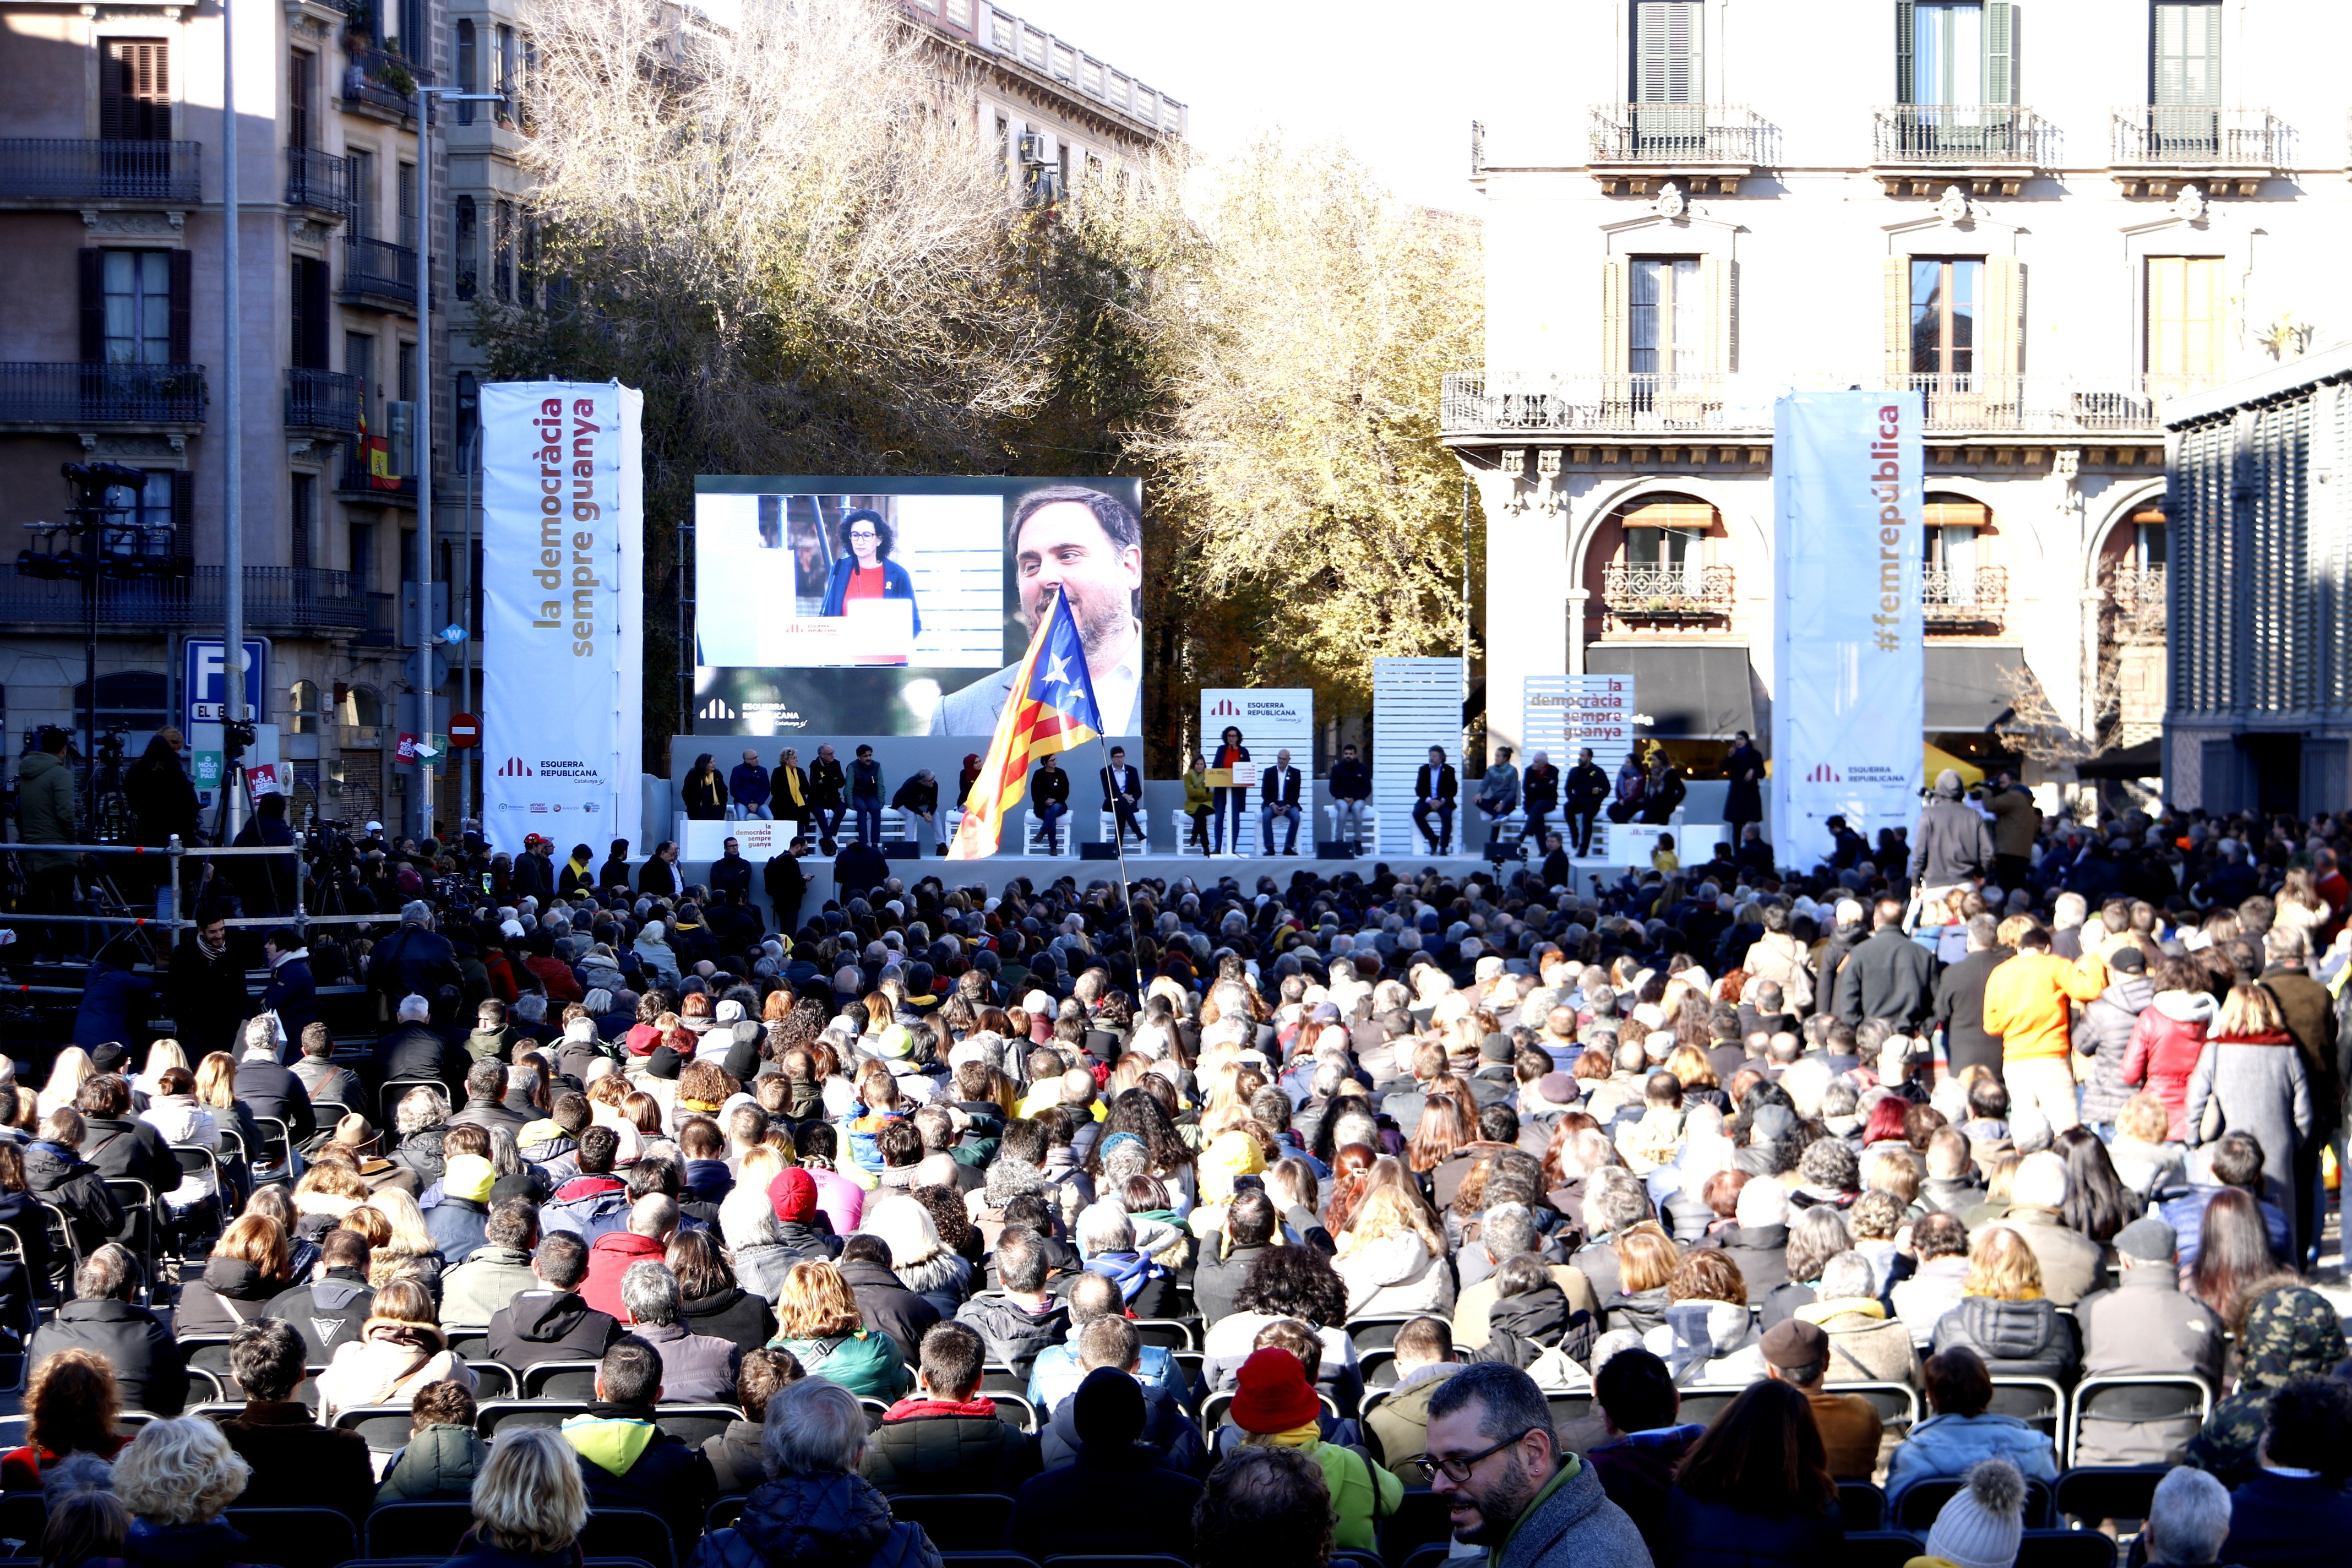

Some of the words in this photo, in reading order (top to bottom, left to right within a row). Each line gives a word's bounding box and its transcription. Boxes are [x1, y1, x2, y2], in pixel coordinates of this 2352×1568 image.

[573, 399, 600, 522] guanya
[532, 399, 562, 590] democràcia
[1871, 405, 1906, 652] #femrepública
[573, 531, 600, 657] sempre
[533, 600, 562, 628] la
[447, 630, 461, 639] W
[1608, 678, 1622, 692] la
[1532, 693, 1622, 707] democràcia
[198, 705, 210, 717] EL
[1563, 711, 1621, 725] sempre
[1564, 727, 1621, 741] guanya
[398, 750, 414, 758] BLICA
[252, 776, 274, 785] HOLA
